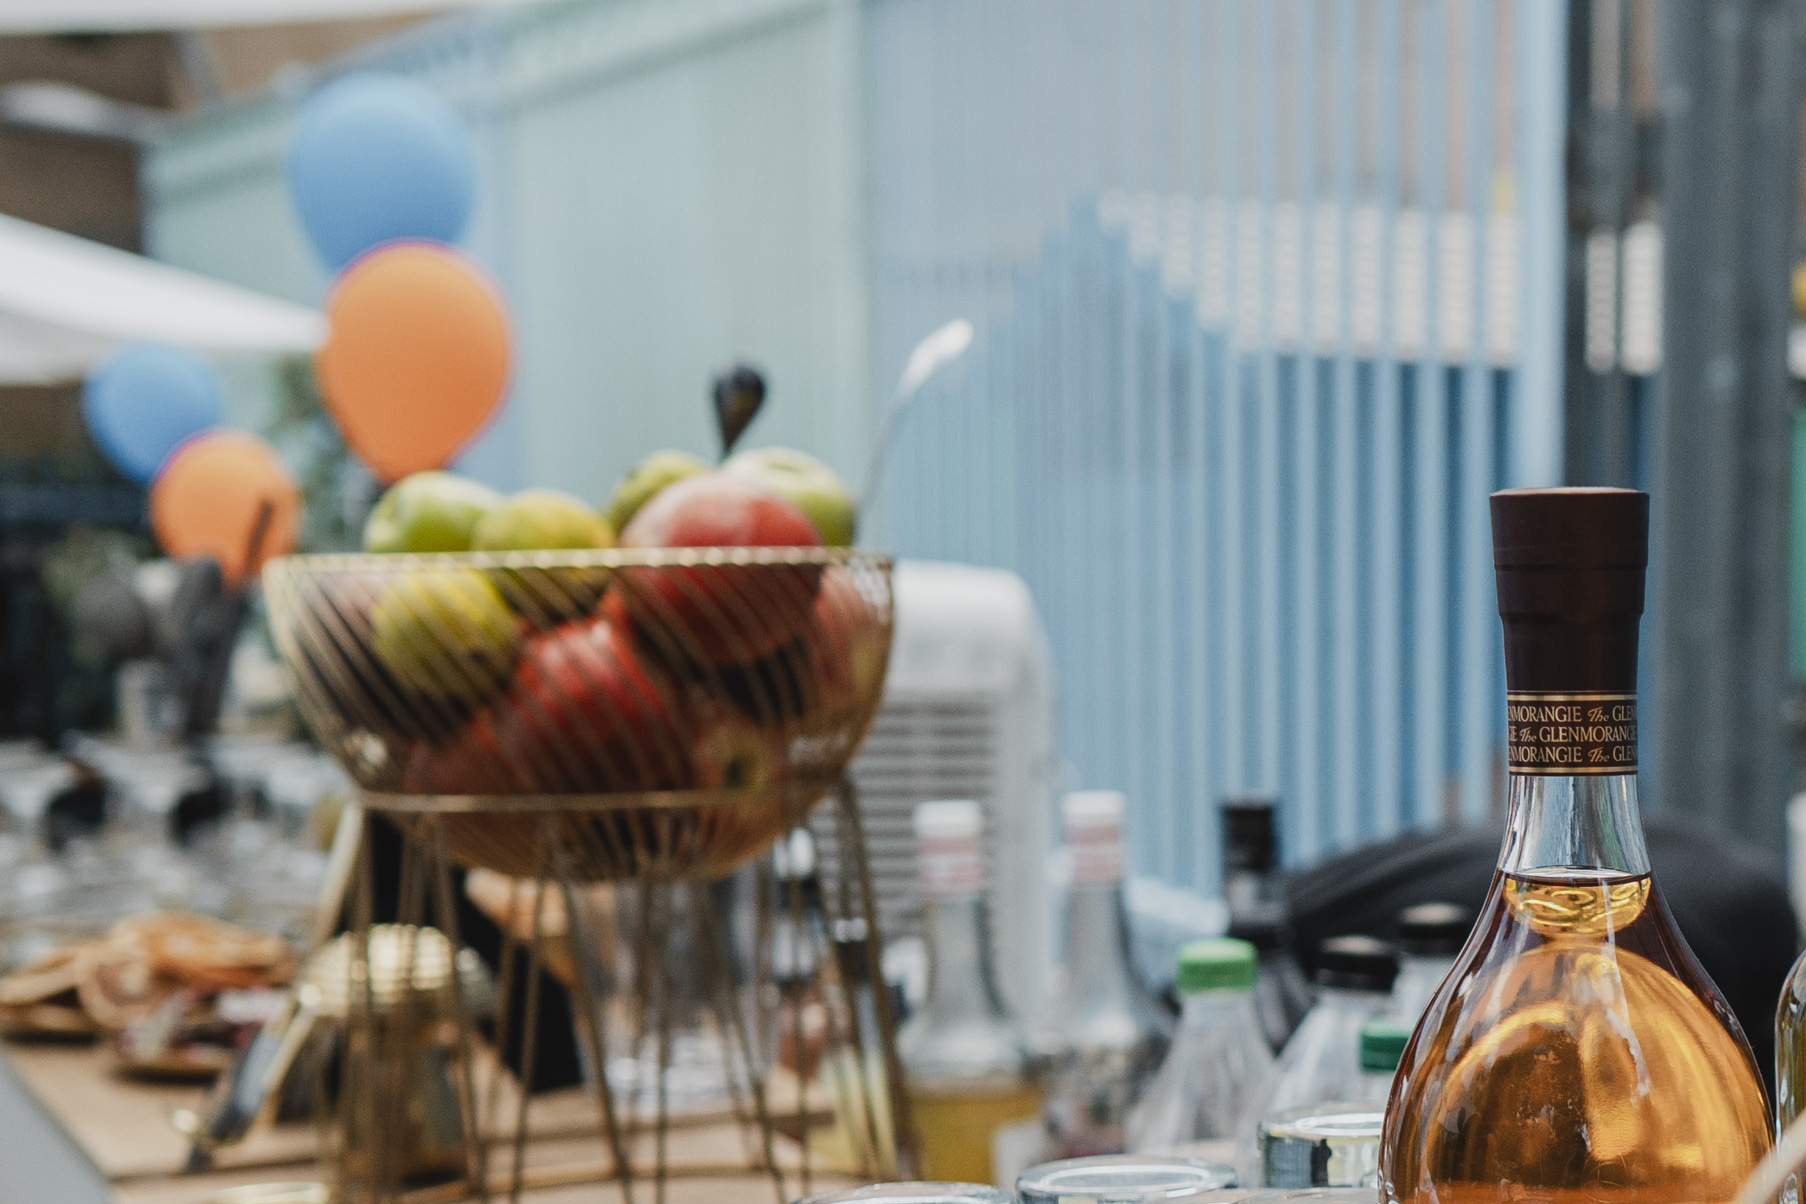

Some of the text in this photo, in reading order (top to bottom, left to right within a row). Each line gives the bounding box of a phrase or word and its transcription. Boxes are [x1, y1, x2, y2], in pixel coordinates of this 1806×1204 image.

[1587, 706, 1610, 722] The
[1519, 726, 1537, 742] The
[1587, 747, 1610, 762] The
